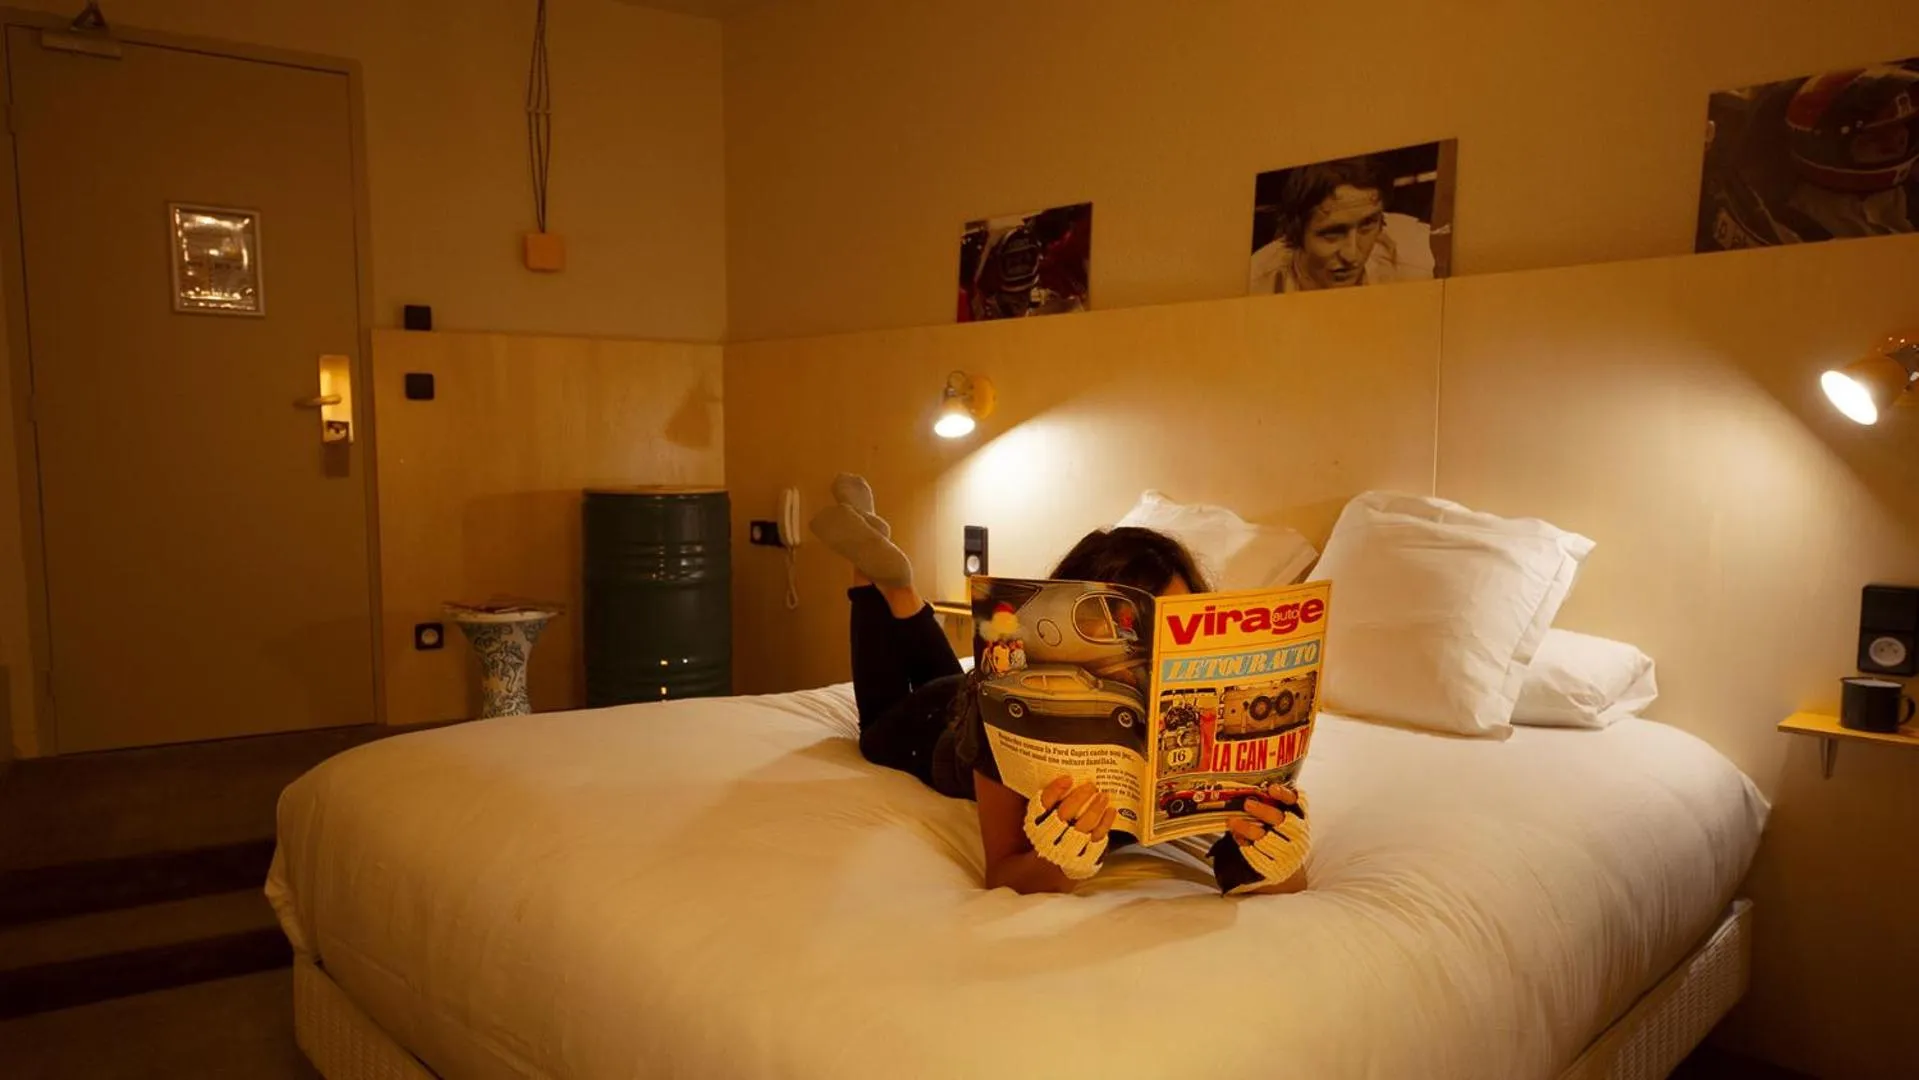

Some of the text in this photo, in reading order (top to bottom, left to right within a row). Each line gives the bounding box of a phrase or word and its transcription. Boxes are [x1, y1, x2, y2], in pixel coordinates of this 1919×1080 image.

[1271, 608, 1300, 623] auto
[1053, 747, 1069, 757] Ford
[1070, 749, 1088, 758] Capri
[1172, 750, 1187, 763] 16
[1211, 742, 1232, 773] LA
